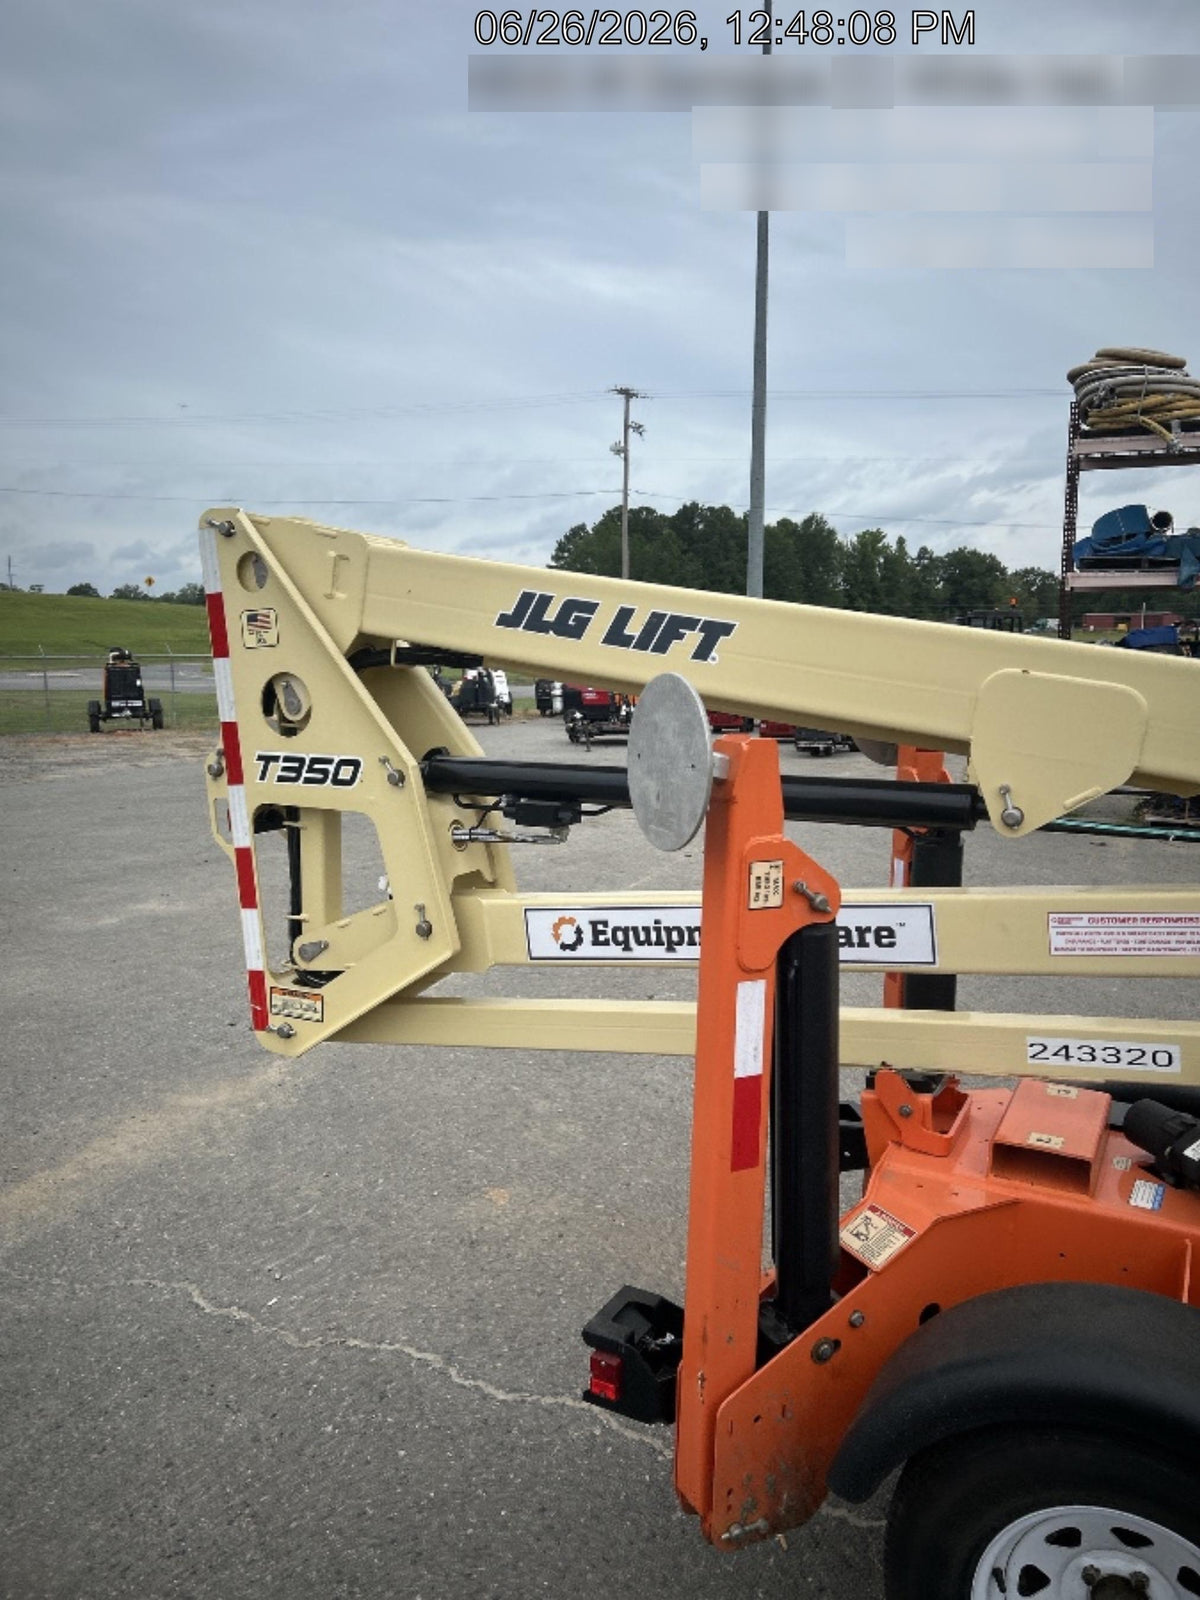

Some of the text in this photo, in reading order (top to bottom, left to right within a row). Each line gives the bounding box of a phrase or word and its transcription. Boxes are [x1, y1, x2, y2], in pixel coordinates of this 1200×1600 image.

[495, 589, 736, 661] JLG LIFT
[255, 754, 362, 787] T350
[1028, 1042, 1173, 1068] 243320
